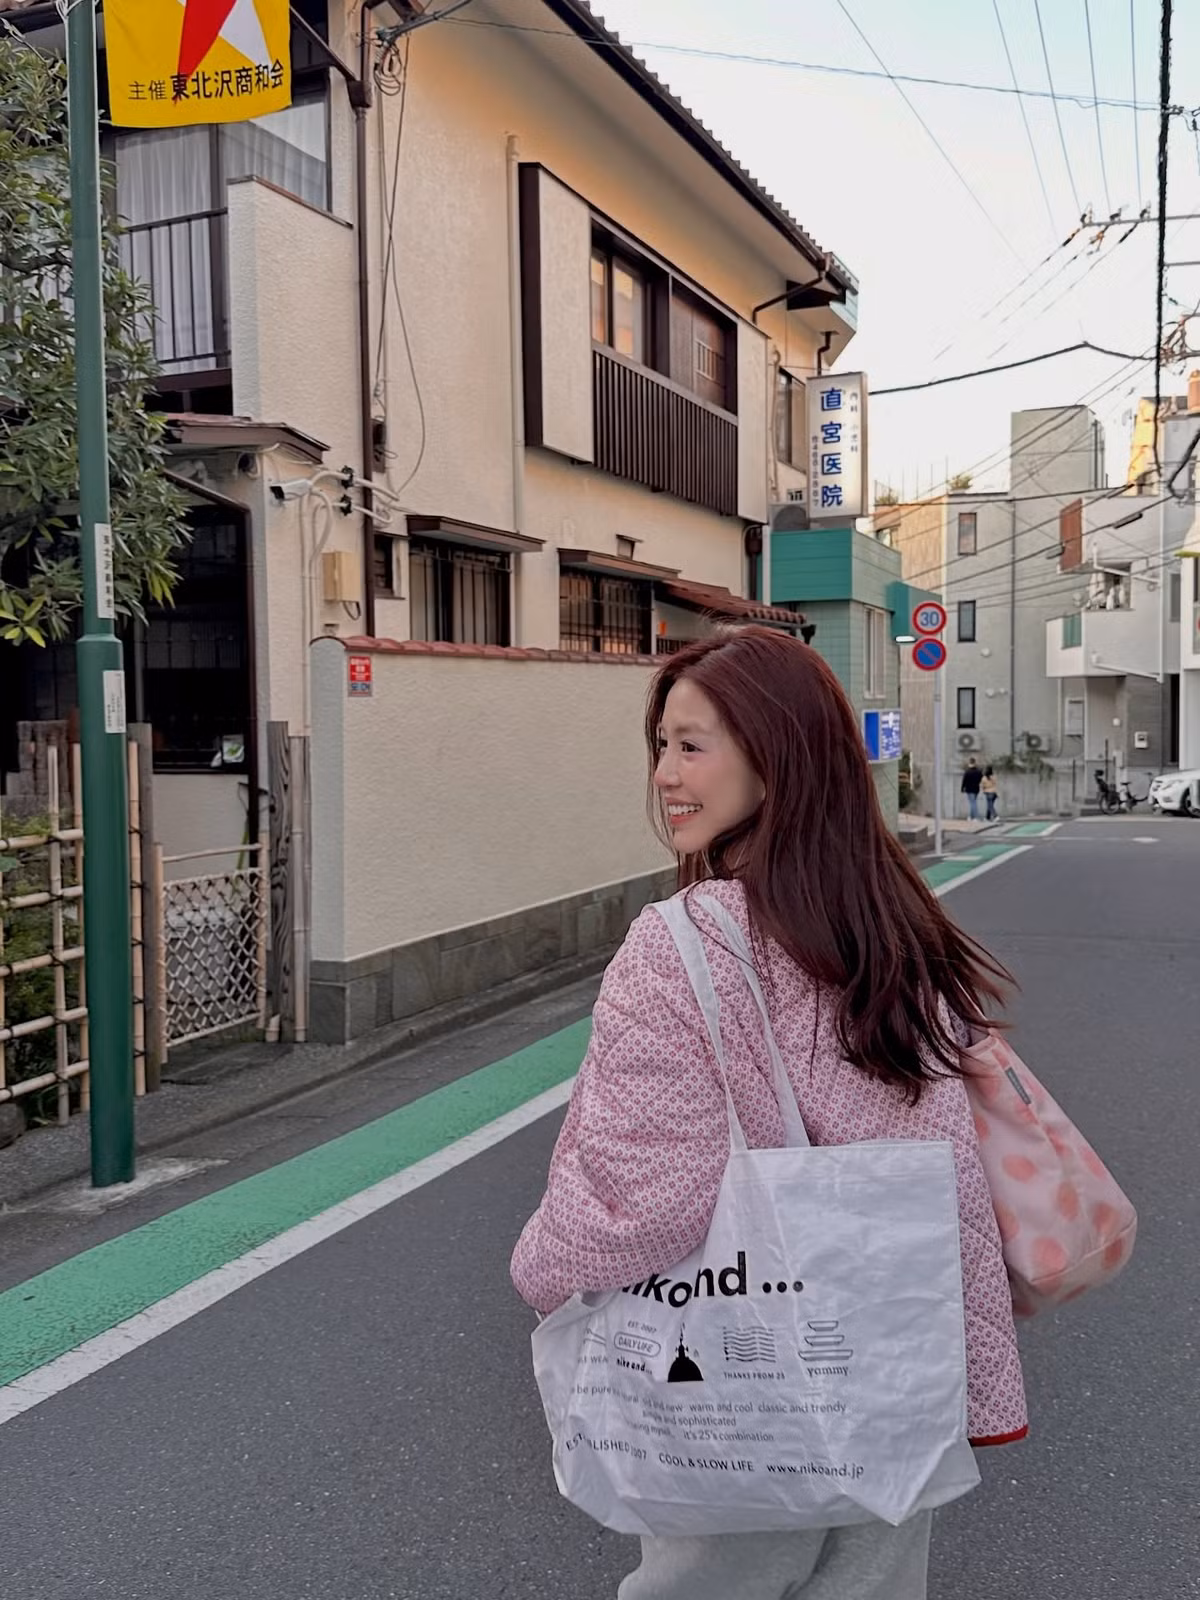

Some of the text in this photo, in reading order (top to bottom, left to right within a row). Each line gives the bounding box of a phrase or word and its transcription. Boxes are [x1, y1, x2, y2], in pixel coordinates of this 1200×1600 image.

[128, 58, 284, 102] 主催 東北沢商和会
[820, 387, 842, 507] 直宮医院
[920, 611, 939, 626] 30
[618, 1336, 654, 1353] DAILY LIFE
[723, 1372, 751, 1380] THANKS
[753, 1372, 774, 1380] FROM
[689, 1404, 714, 1412] warm
[717, 1403, 732, 1412] and
[734, 1402, 753, 1413] cool
[758, 1402, 788, 1413] classic
[790, 1403, 808, 1413] and
[811, 1402, 846, 1415] trendy
[678, 1415, 737, 1428] sophisticated
[719, 1431, 775, 1442] combination
[658, 1452, 685, 1467] COOL
[688, 1459, 696, 1467] &
[697, 1460, 728, 1471] SLOW
[731, 1460, 755, 1472] LIFE
[766, 1462, 865, 1480] www.nikoand.jp
